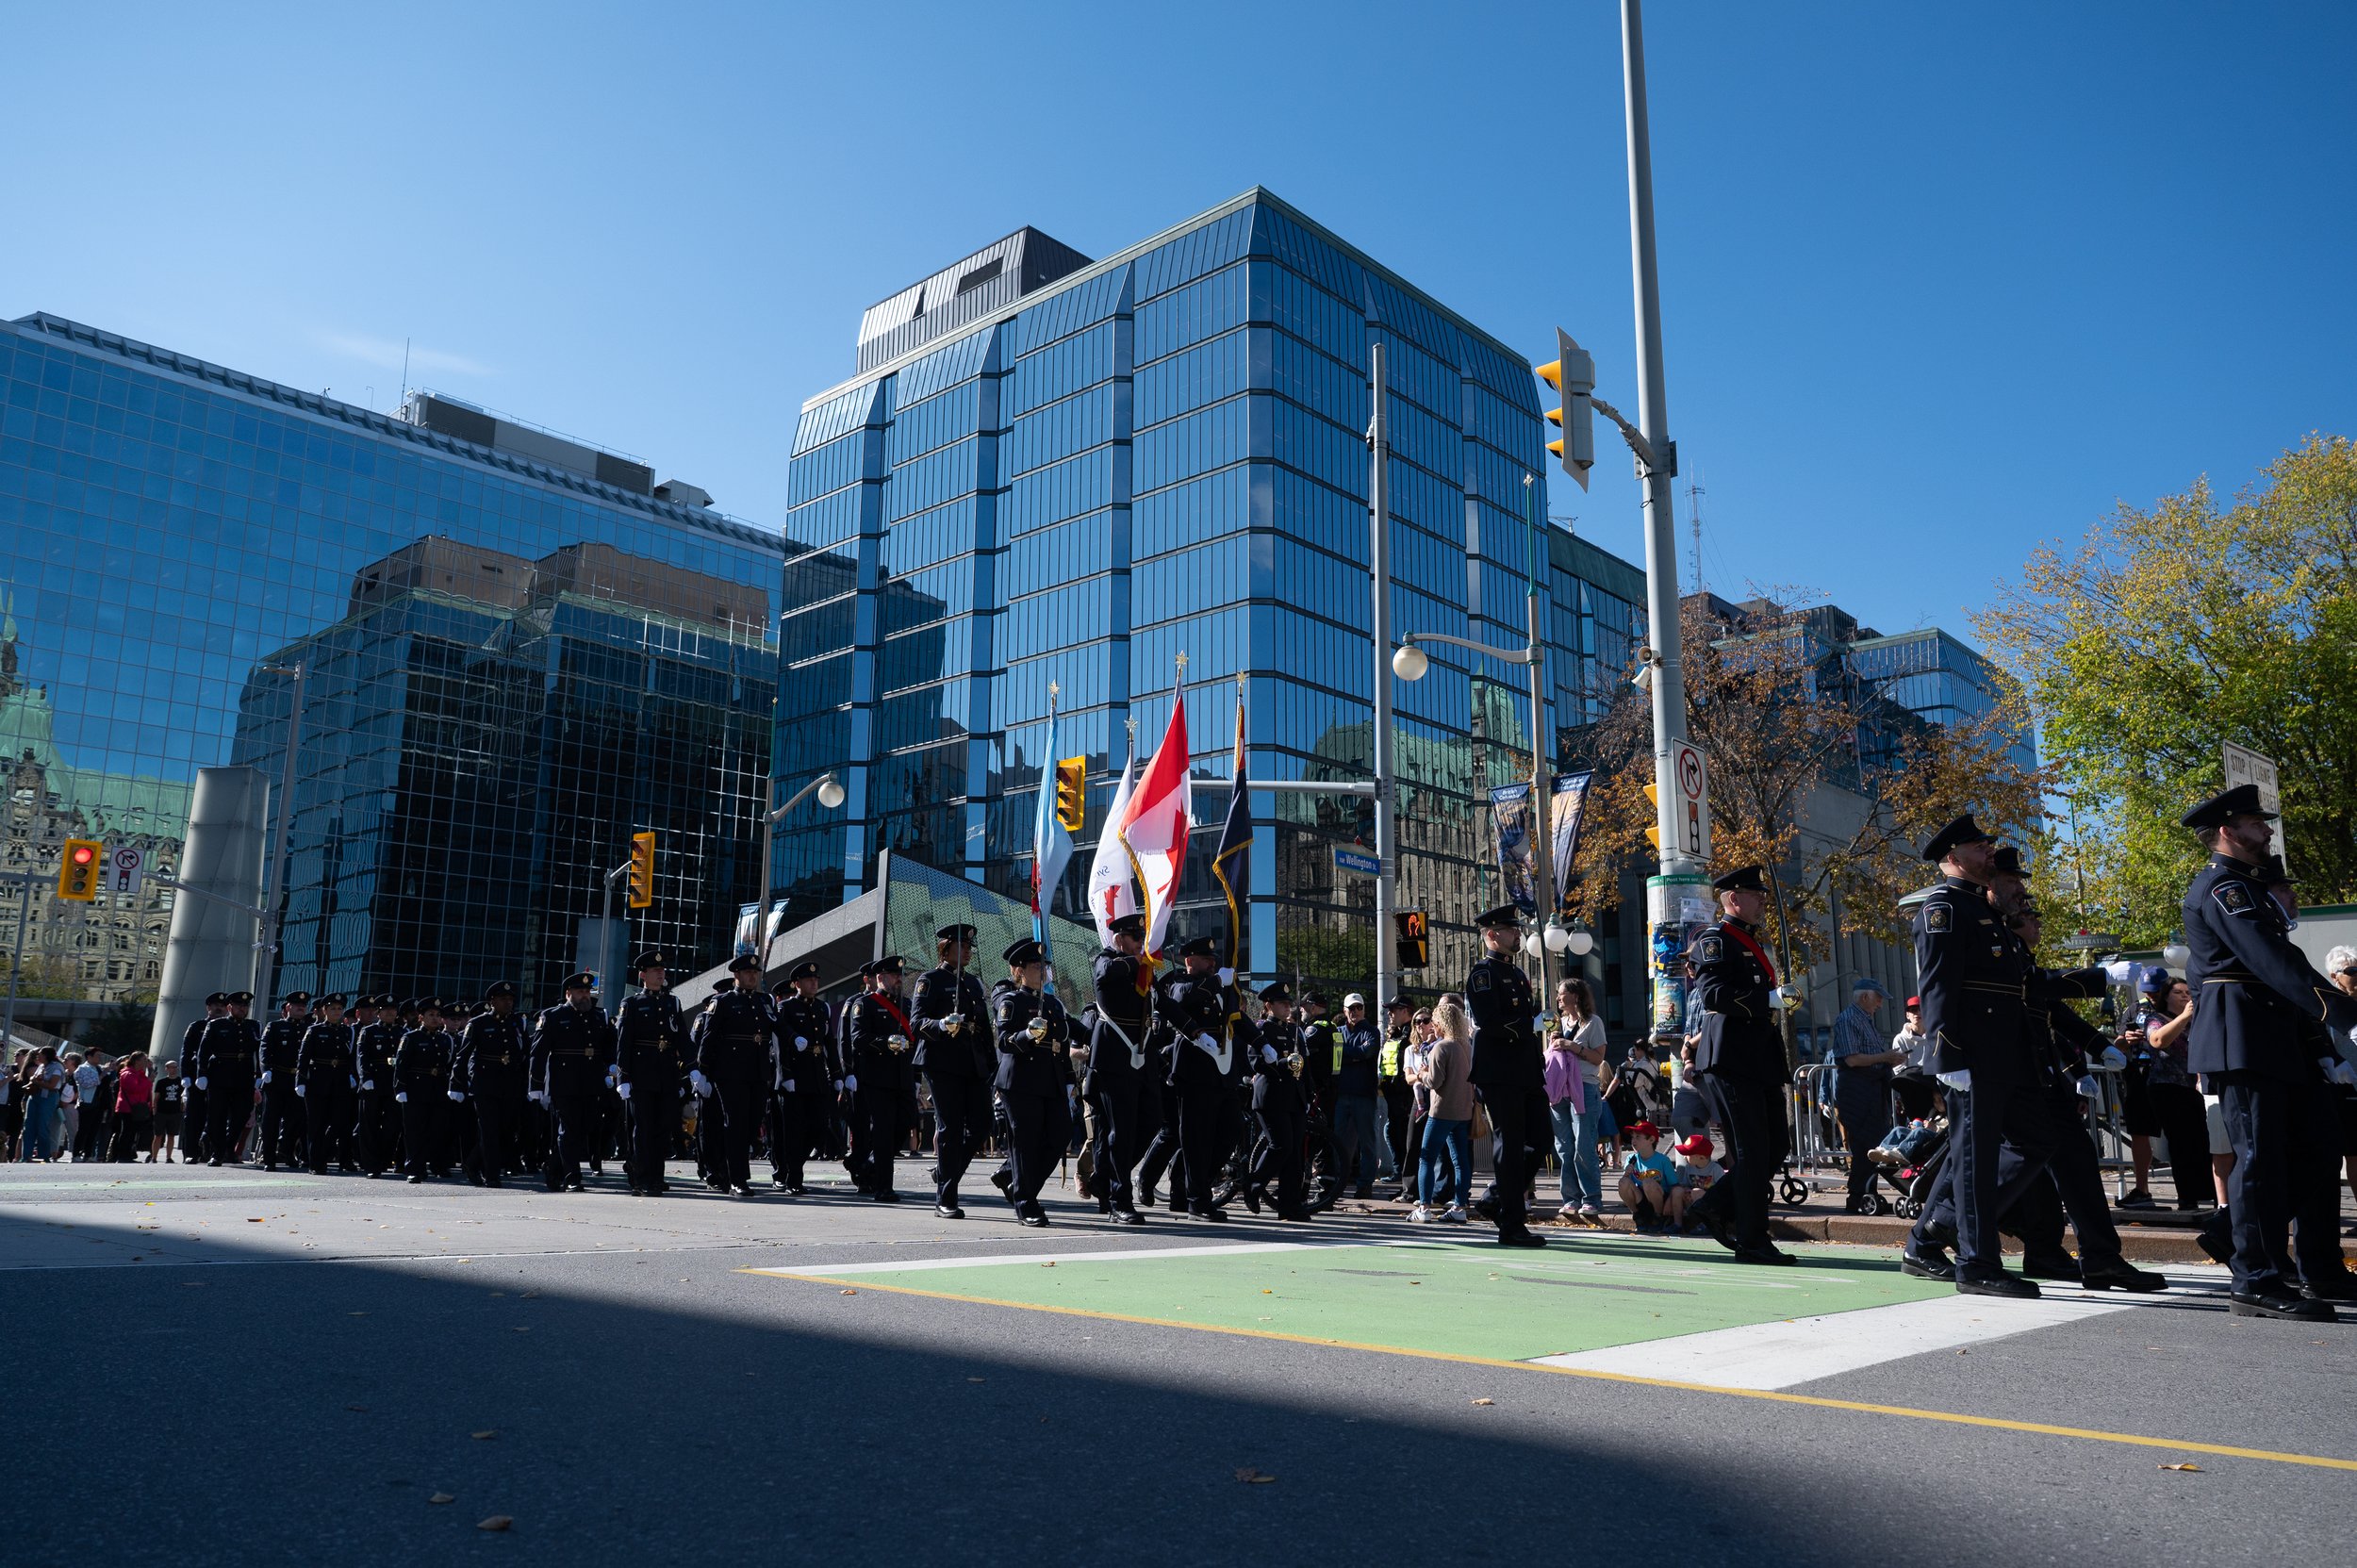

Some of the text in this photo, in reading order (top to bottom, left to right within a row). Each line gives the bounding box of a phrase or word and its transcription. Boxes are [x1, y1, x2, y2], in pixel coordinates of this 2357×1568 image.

[2231, 753, 2246, 774] STOP
[2254, 764, 2272, 785] LIGNE
[1345, 853, 1373, 871] Wellington
